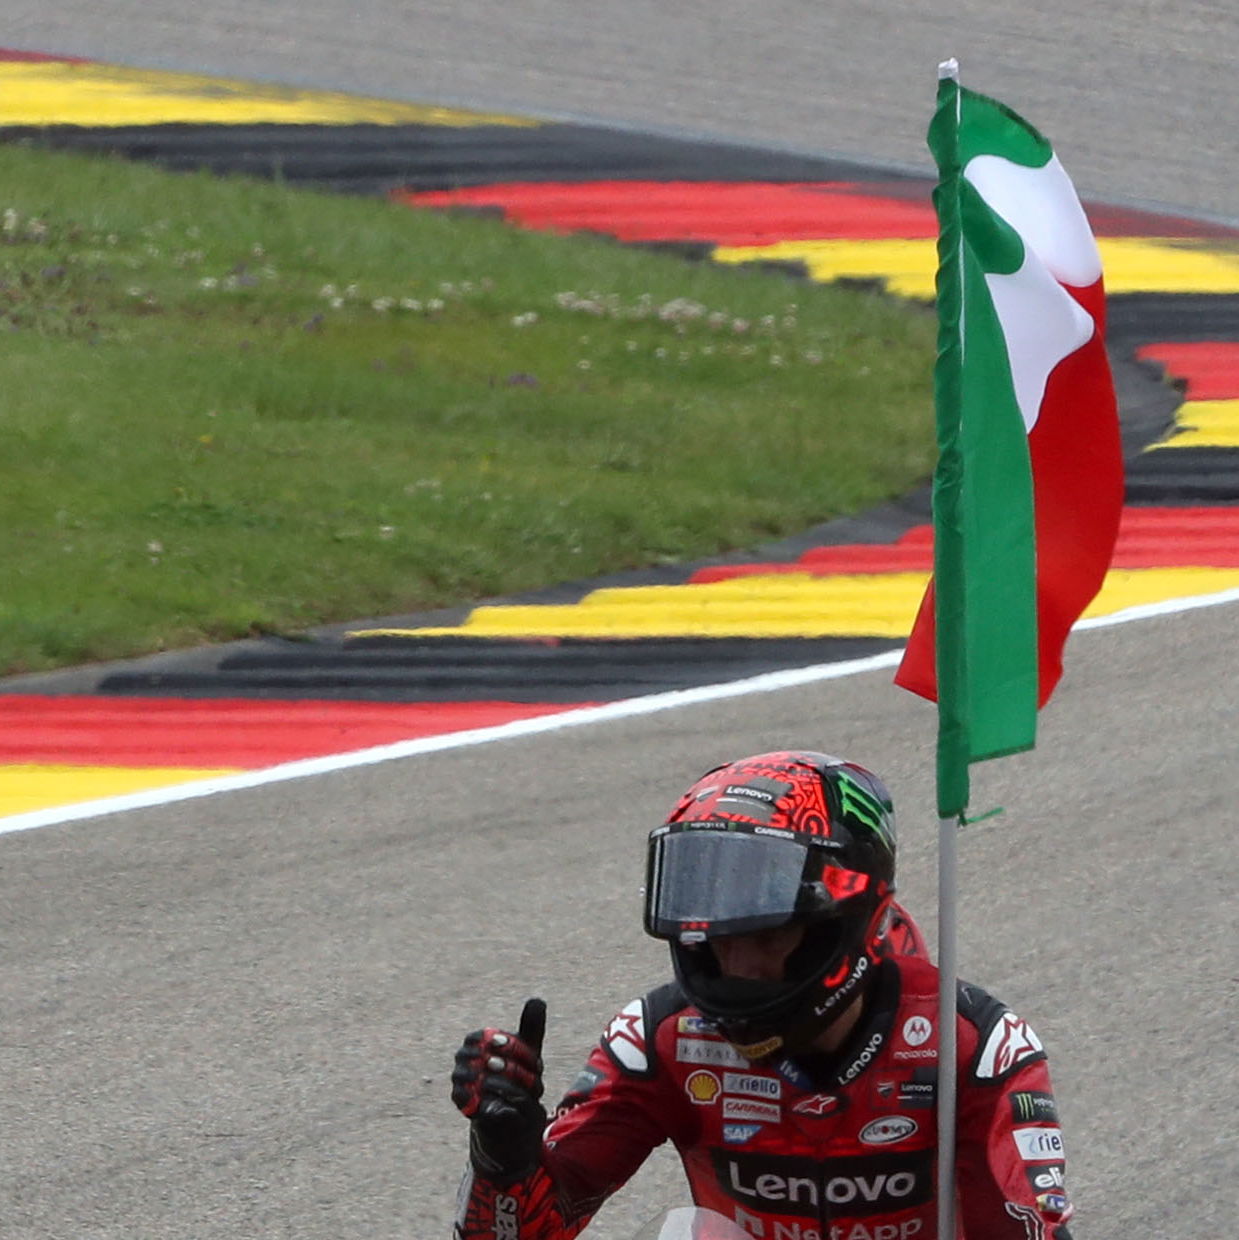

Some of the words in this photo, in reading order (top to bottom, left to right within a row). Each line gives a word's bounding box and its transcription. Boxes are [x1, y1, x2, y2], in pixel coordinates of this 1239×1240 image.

[725, 786, 773, 802] Lenovo
[814, 956, 868, 1017] Lenovo
[837, 1032, 884, 1086] Lenovo
[779, 1060, 799, 1083] IM
[724, 1127, 756, 1141] SAP
[1037, 1132, 1063, 1152] rie
[729, 1161, 917, 1206] Lenovo
